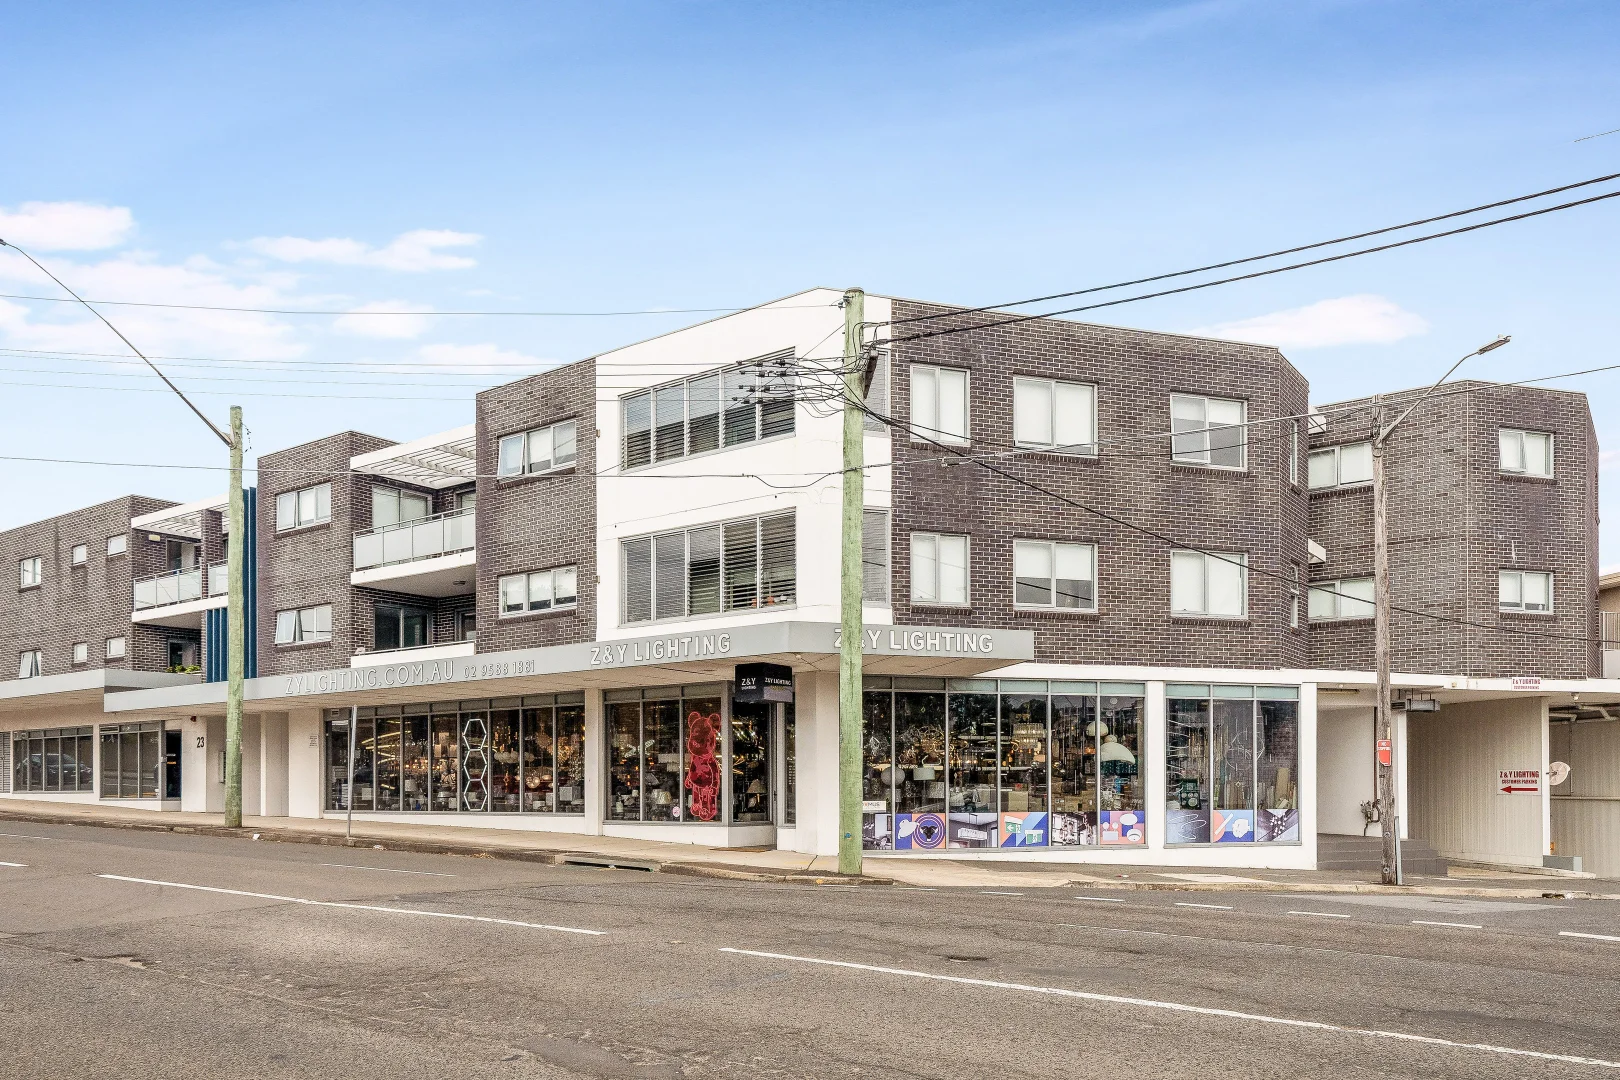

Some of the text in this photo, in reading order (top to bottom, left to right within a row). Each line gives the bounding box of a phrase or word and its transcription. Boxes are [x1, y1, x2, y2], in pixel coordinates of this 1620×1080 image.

[590, 633, 731, 666] Z&Y LIGHTING
[834, 628, 993, 653] ZY LIGHTING
[285, 660, 535, 694] ZYLIGHTING.COM.AU 02 9588 1881
[741, 677, 756, 686] Z&Y
[197, 737, 204, 748] 23
